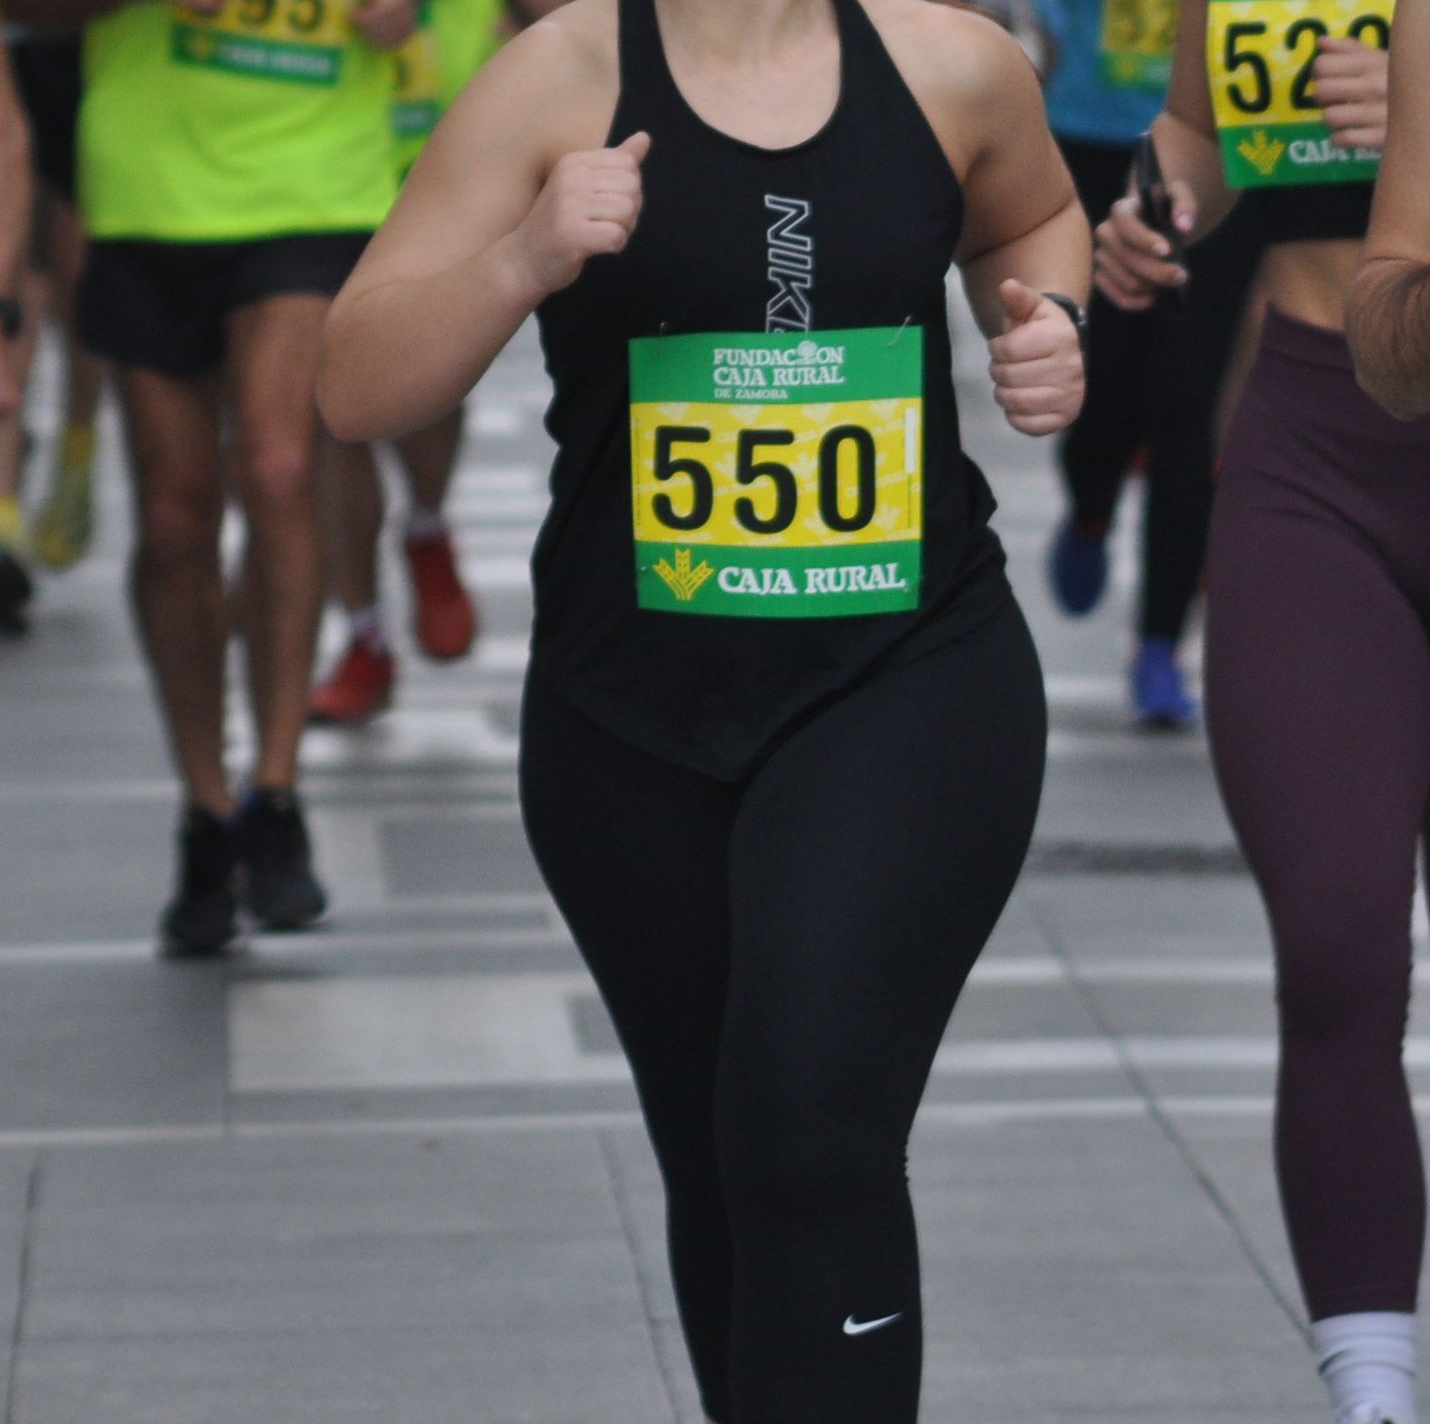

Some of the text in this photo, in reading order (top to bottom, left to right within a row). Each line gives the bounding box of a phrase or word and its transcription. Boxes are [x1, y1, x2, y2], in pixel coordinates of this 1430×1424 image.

[764, 193, 812, 333] NIK
[713, 365, 846, 388] CAJA RURAL
[714, 388, 789, 400] DE ZAMORA
[651, 423, 877, 534] 550
[717, 562, 907, 596] CAJA RURAL
